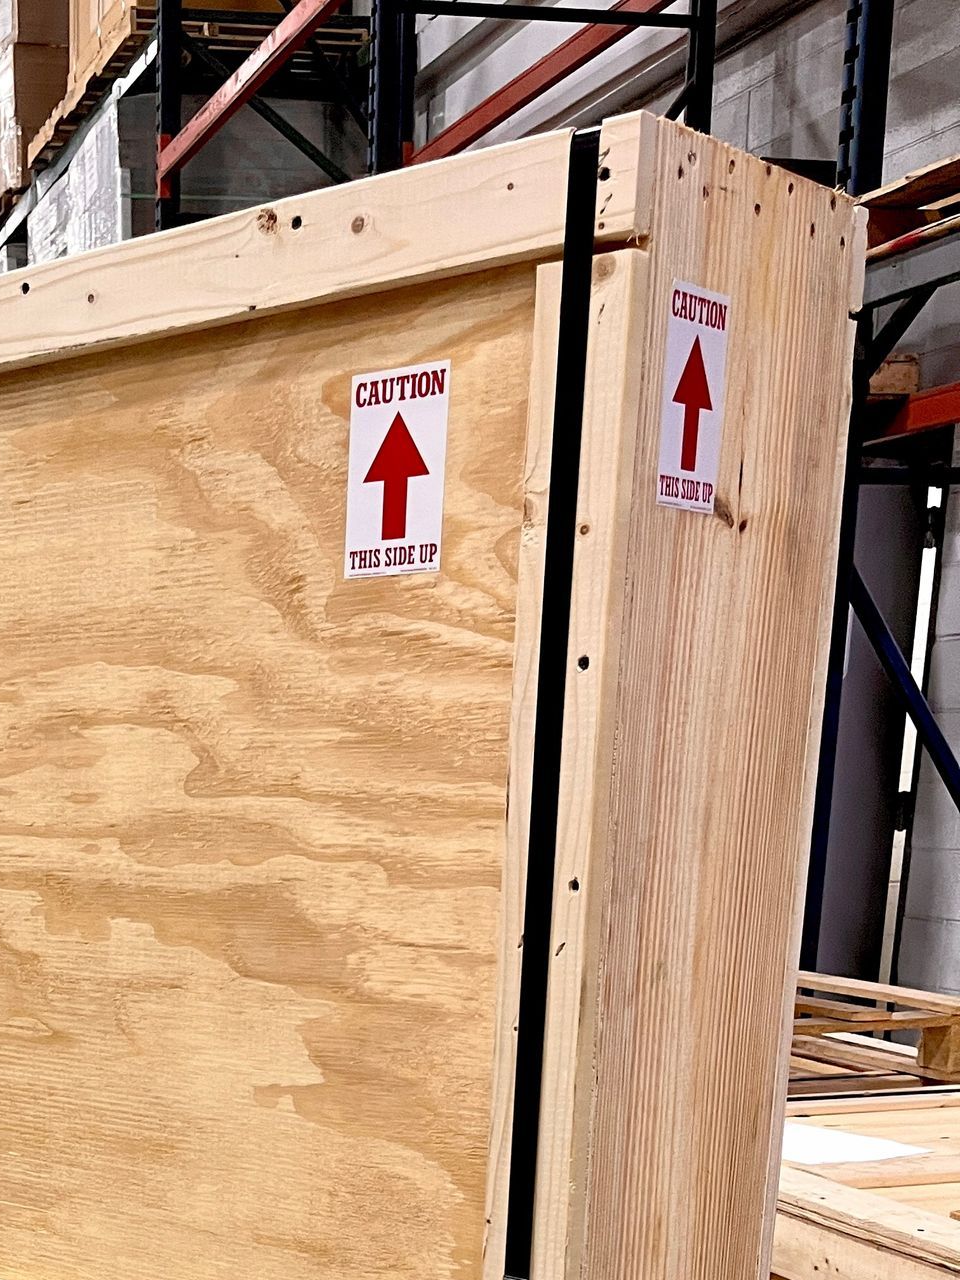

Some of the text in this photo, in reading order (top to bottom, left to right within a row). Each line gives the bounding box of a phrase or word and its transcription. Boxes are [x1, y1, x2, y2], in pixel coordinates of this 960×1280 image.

[672, 289, 727, 331] CAUTION
[355, 368, 447, 408] CAUTION
[660, 474, 713, 504] THIS SIDE UP
[350, 543, 438, 570] THIS SIDE UP
